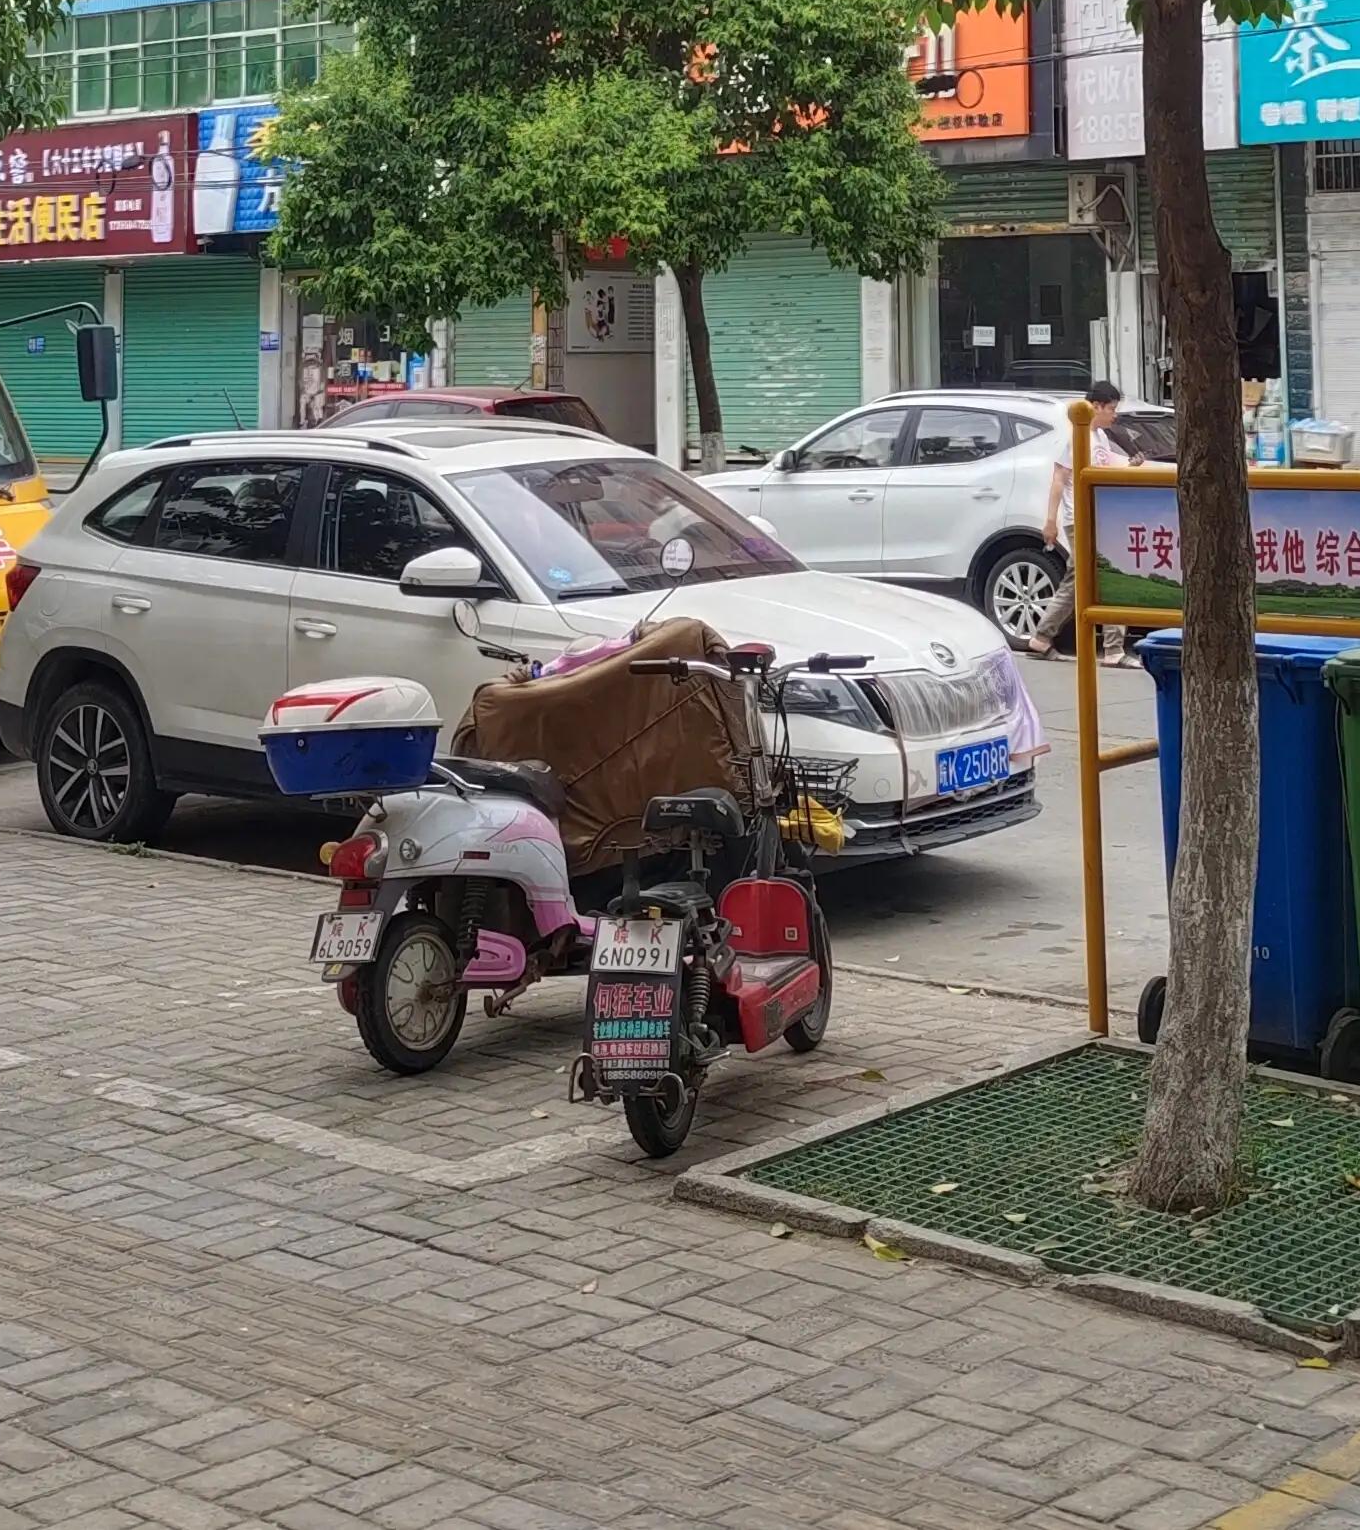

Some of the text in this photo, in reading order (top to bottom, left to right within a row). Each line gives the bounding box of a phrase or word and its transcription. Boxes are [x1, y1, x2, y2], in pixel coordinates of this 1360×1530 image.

[1127, 524, 1306, 575] 平安我他
[357, 921, 367, 937] K
[613, 926, 662, 946] 皖 K
[317, 937, 372, 960] 6L9059
[597, 946, 672, 969] 6N0991
[593, 981, 674, 1019] 何猛车业
